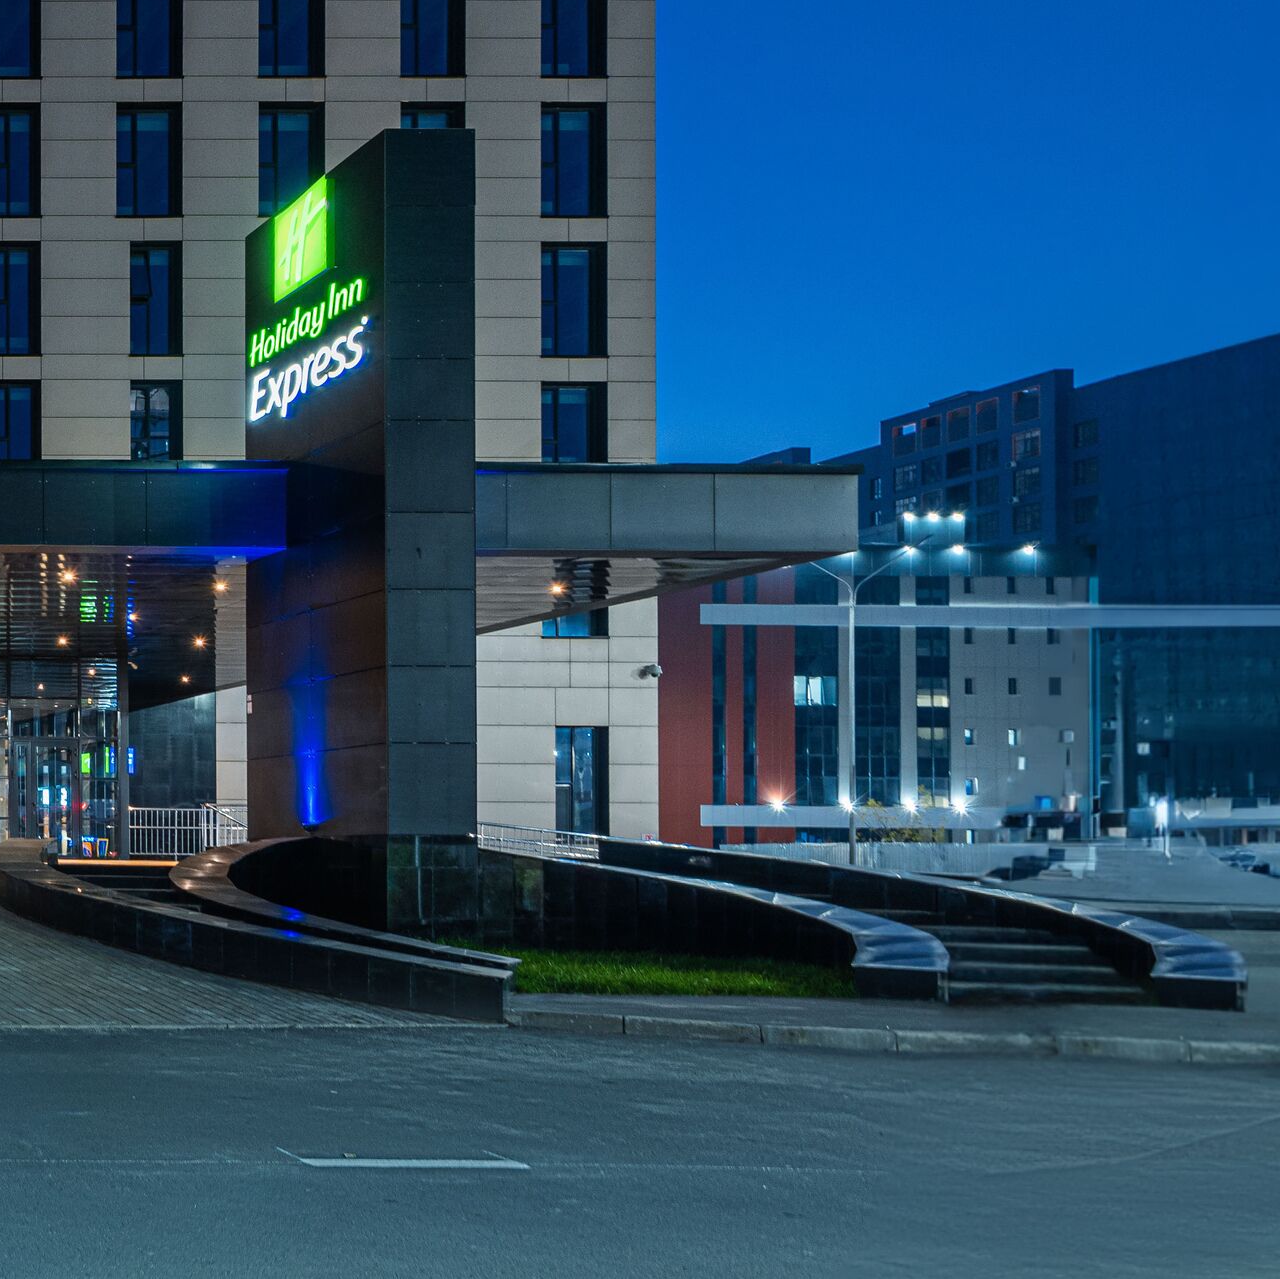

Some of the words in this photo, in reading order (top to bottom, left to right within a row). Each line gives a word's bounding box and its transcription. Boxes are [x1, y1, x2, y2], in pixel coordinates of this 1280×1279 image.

[249, 301, 325, 368] Holiday
[327, 277, 364, 320] Inn
[249, 325, 365, 422] Express
